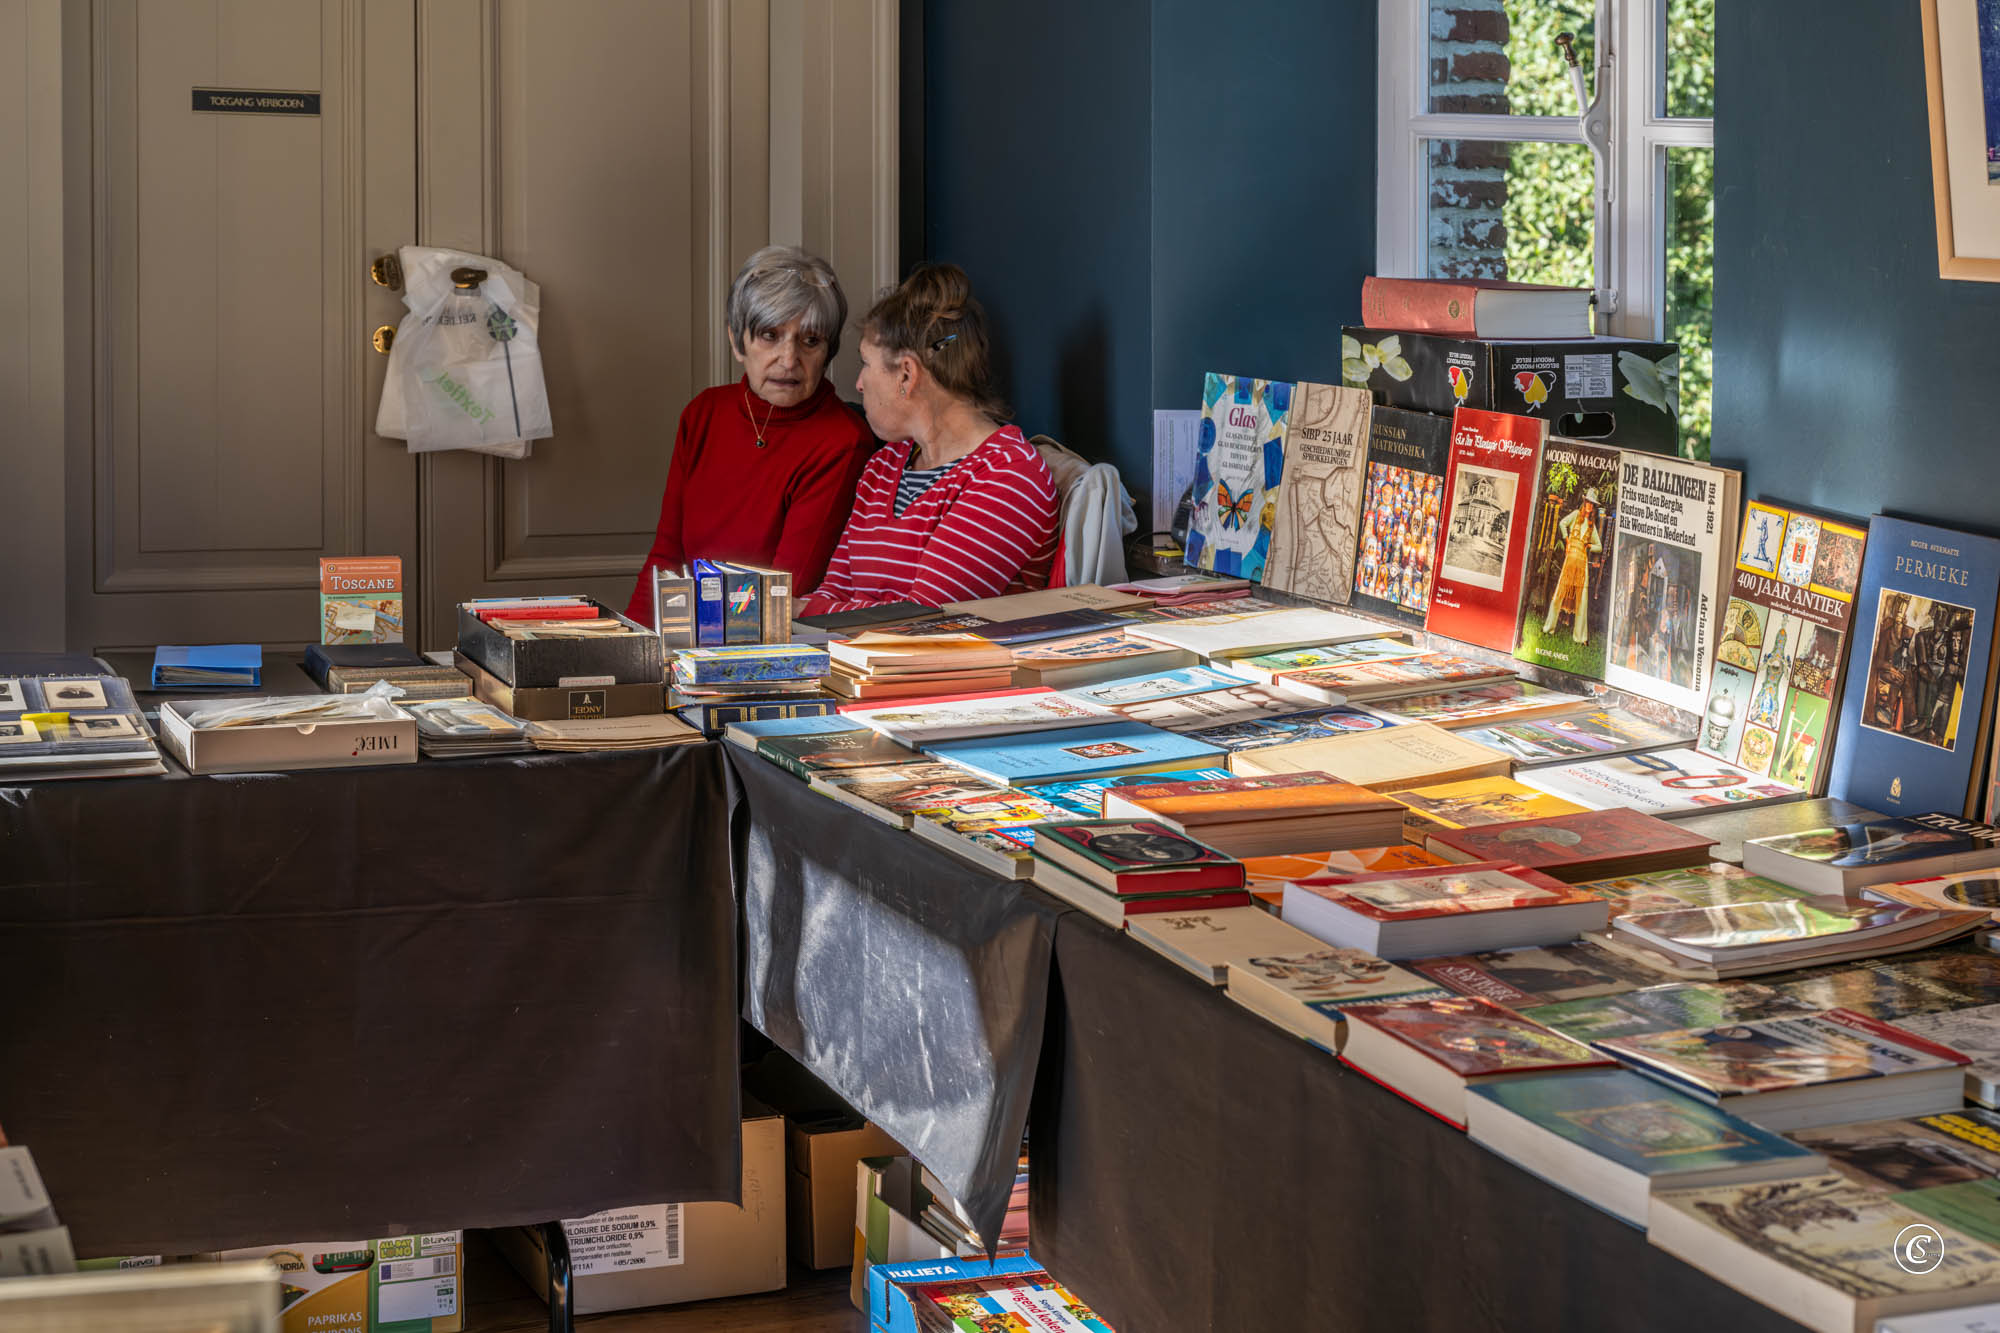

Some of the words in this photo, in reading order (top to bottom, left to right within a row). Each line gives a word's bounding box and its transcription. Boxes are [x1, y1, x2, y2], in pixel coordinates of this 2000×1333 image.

[209, 96, 254, 106] TOEGANG
[256, 98, 304, 108] VERBODEN
[1229, 407, 1257, 429] Glas
[1302, 427, 1321, 441] SIBP
[1322, 430, 1332, 442] 25
[1332, 431, 1353, 446] JAAR
[1373, 424, 1408, 440] RUSSIAN
[1372, 438, 1425, 459] MATRYOSHKA
[1546, 449, 1577, 465] MODERN
[1579, 454, 1621, 472] MACRAM
[1623, 463, 1639, 486] DE
[1641, 467, 1707, 502] BALLINGEN
[1622, 486, 1637, 501] Frits
[1638, 492, 1649, 503] van
[1649, 492, 1660, 507] den
[1660, 494, 1683, 515] Berghe,
[1706, 481, 1717, 535] 1914-1921
[1620, 501, 1645, 519] Gustave
[1645, 507, 1654, 520] De
[1654, 508, 1670, 523] Smet
[1670, 514, 1678, 526] en
[1620, 515, 1631, 529] Rik
[1631, 518, 1656, 537] Wouters
[1656, 524, 1663, 538] in
[1663, 526, 1696, 546] Nederland
[1911, 540, 1928, 550] ROGER
[1895, 555, 1969, 587] PERMEKE
[1737, 572, 1756, 591] 400
[1754, 577, 1791, 602] JAAR
[1792, 588, 1846, 618] ANTIEK
[1698, 594, 1709, 644] Adriaan
[1916, 813, 2000, 842] TRUM
[566, 1225, 599, 1236] HLORURE
[600, 1224, 610, 1233] DE
[612, 1222, 639, 1232] SODIUM
[640, 1220, 656, 1229] 0,9%
[569, 1234, 627, 1247] TRIUMCHLORIDE
[628, 1231, 645, 1240] 0,9%
[380, 1241, 394, 1249] ALL
[394, 1239, 412, 1247] DAY
[380, 1247, 412, 1259] LONG
[1000, 1281, 1047, 1314] Swingend
[307, 1311, 362, 1328] PAPRIKAS
